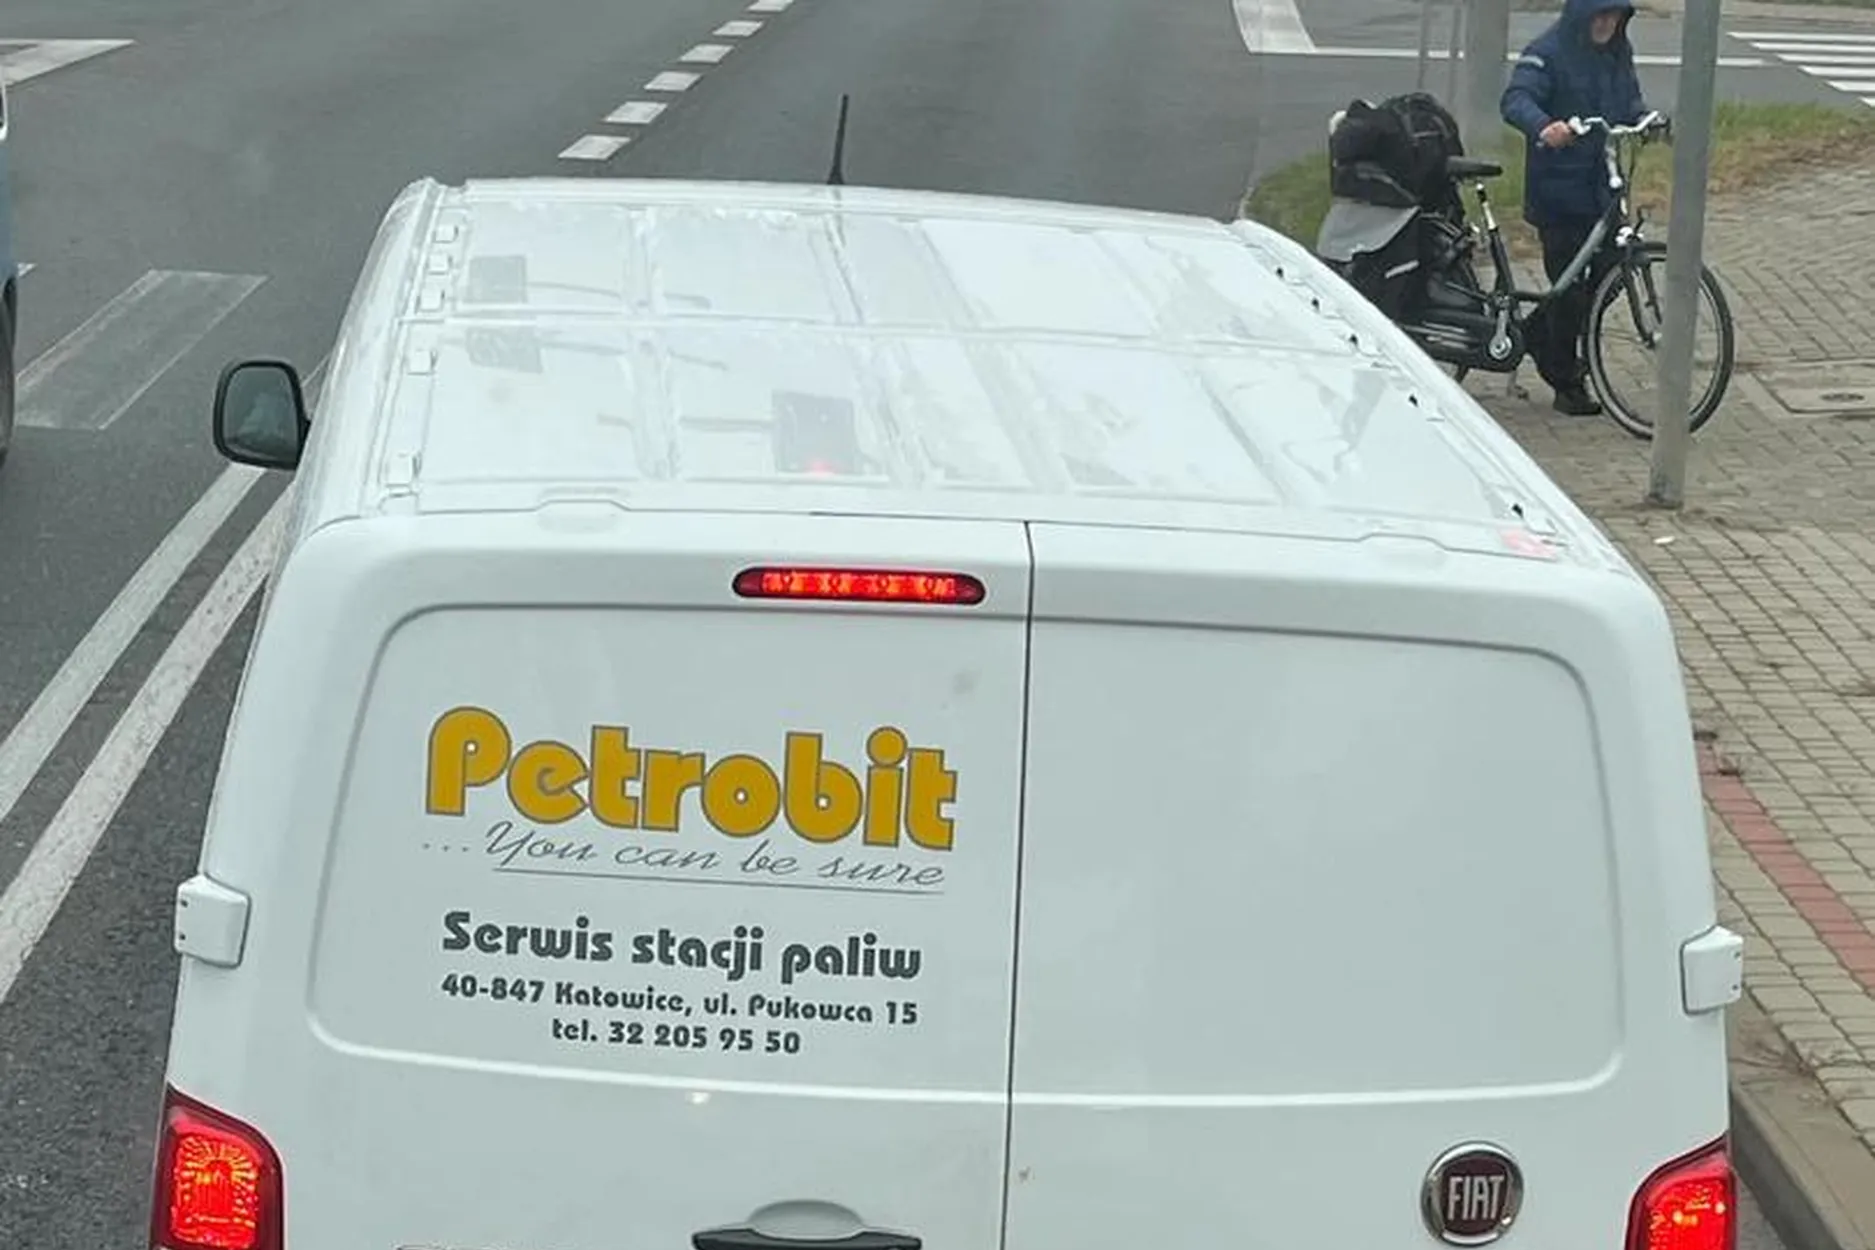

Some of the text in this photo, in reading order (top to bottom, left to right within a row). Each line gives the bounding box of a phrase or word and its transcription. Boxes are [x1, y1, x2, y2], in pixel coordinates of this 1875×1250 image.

[425, 706, 957, 851] Petrobit
[614, 844, 720, 871] can
[740, 840, 801, 876] be
[816, 858, 945, 886] sure
[442, 911, 922, 985] Serwis stacji paliw
[441, 973, 918, 1025] 40-847 Katowice, ul. Pukowca 15
[552, 1018, 801, 1054] tel. 32 205 95 50
[1448, 1175, 1505, 1222] FIAT
